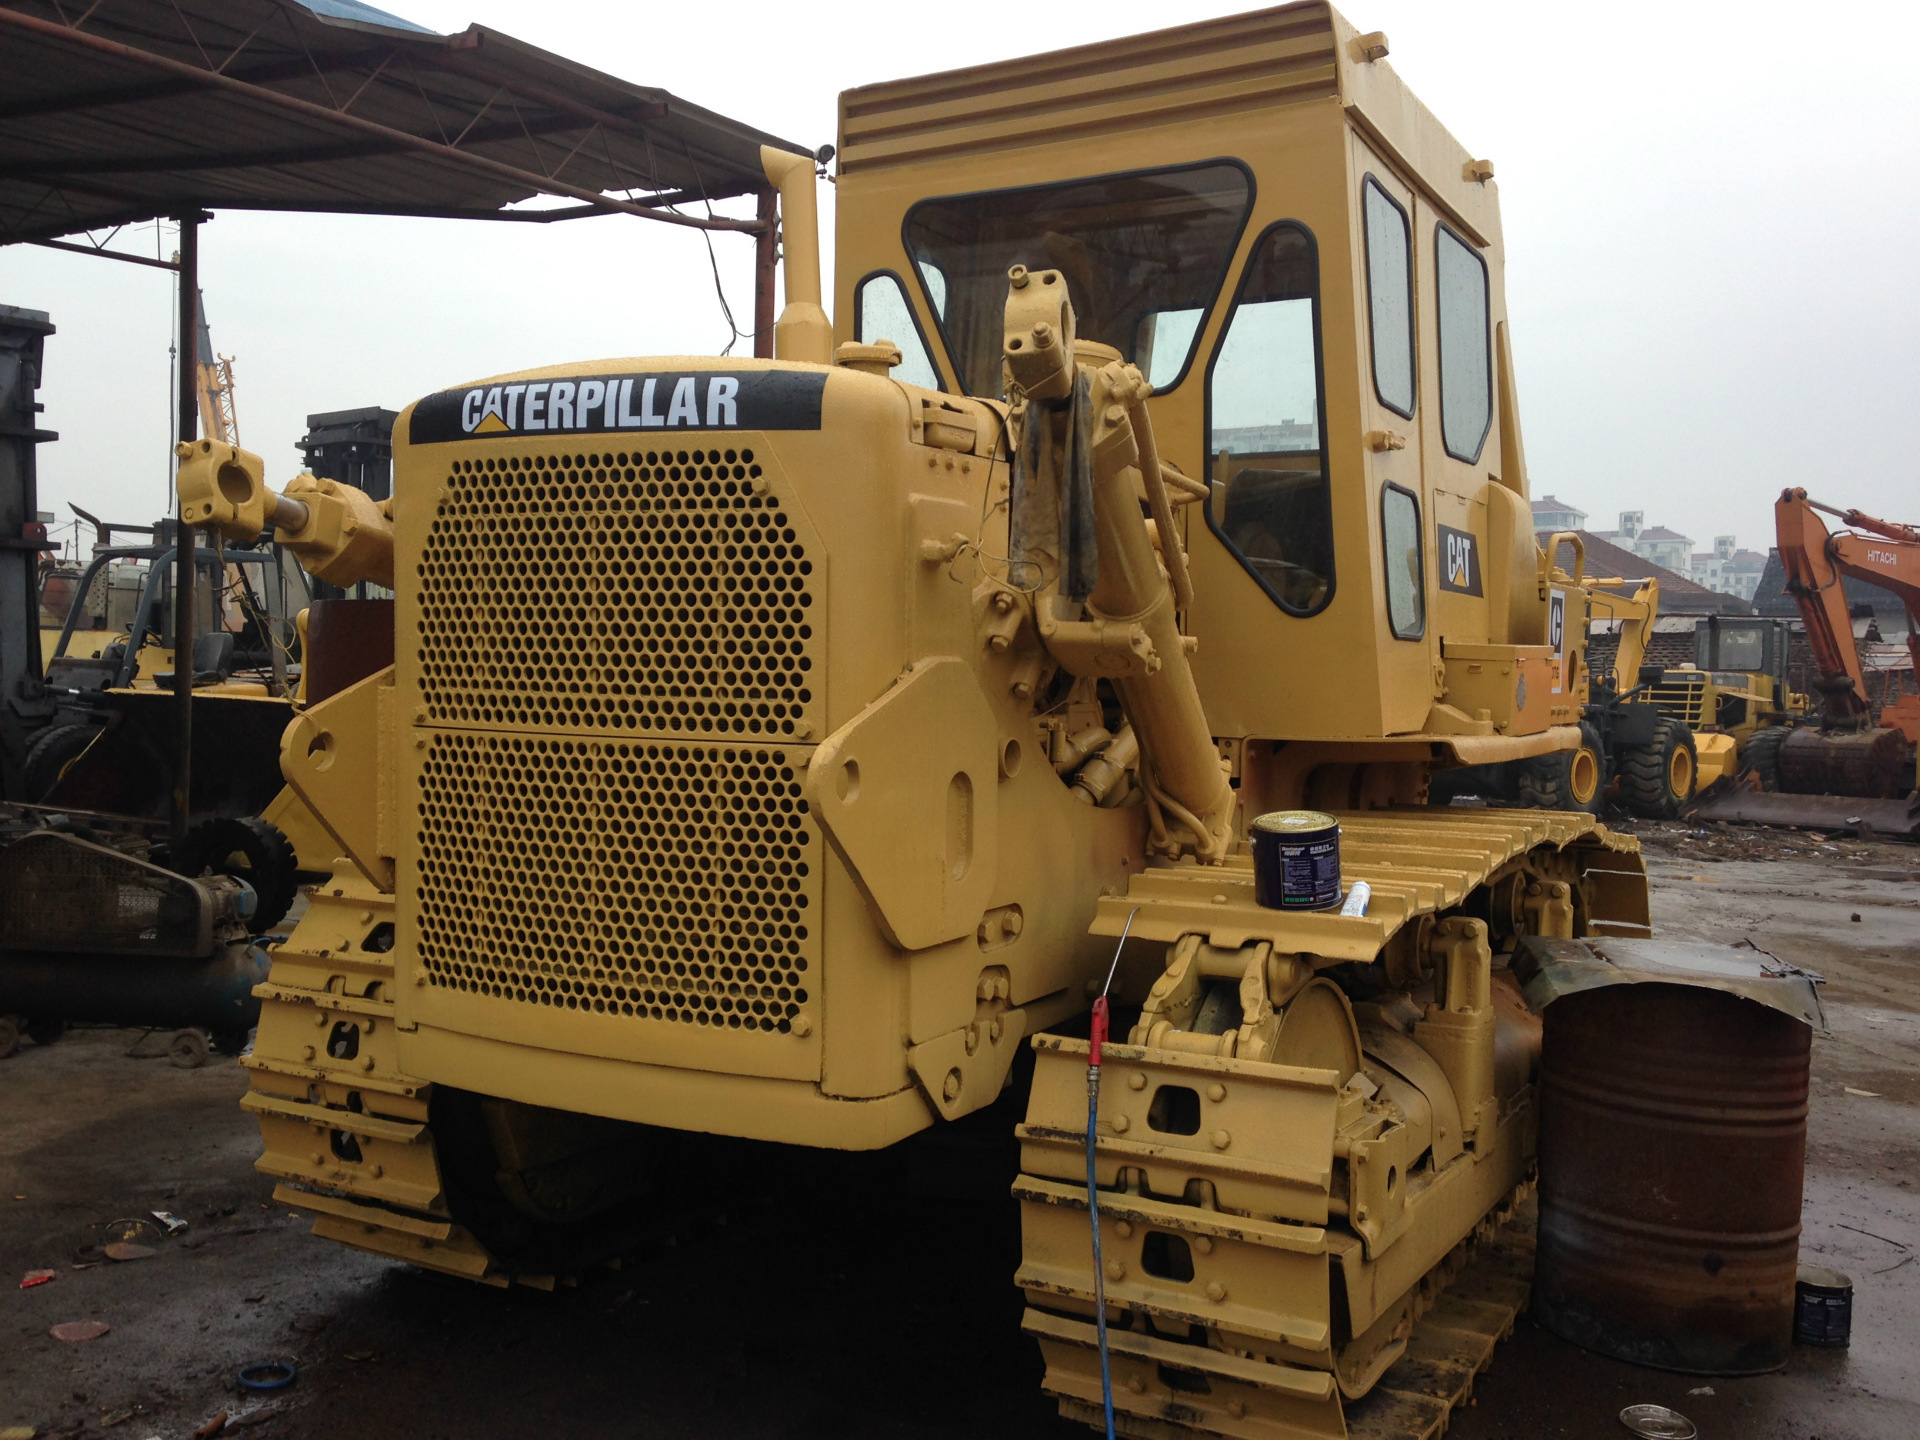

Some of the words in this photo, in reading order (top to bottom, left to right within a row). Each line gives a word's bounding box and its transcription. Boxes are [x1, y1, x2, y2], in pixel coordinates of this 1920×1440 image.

[461, 376, 739, 433] CATERPILLAR
[1447, 533, 1471, 587] CAT
[1867, 549, 1897, 565] HITACHI
